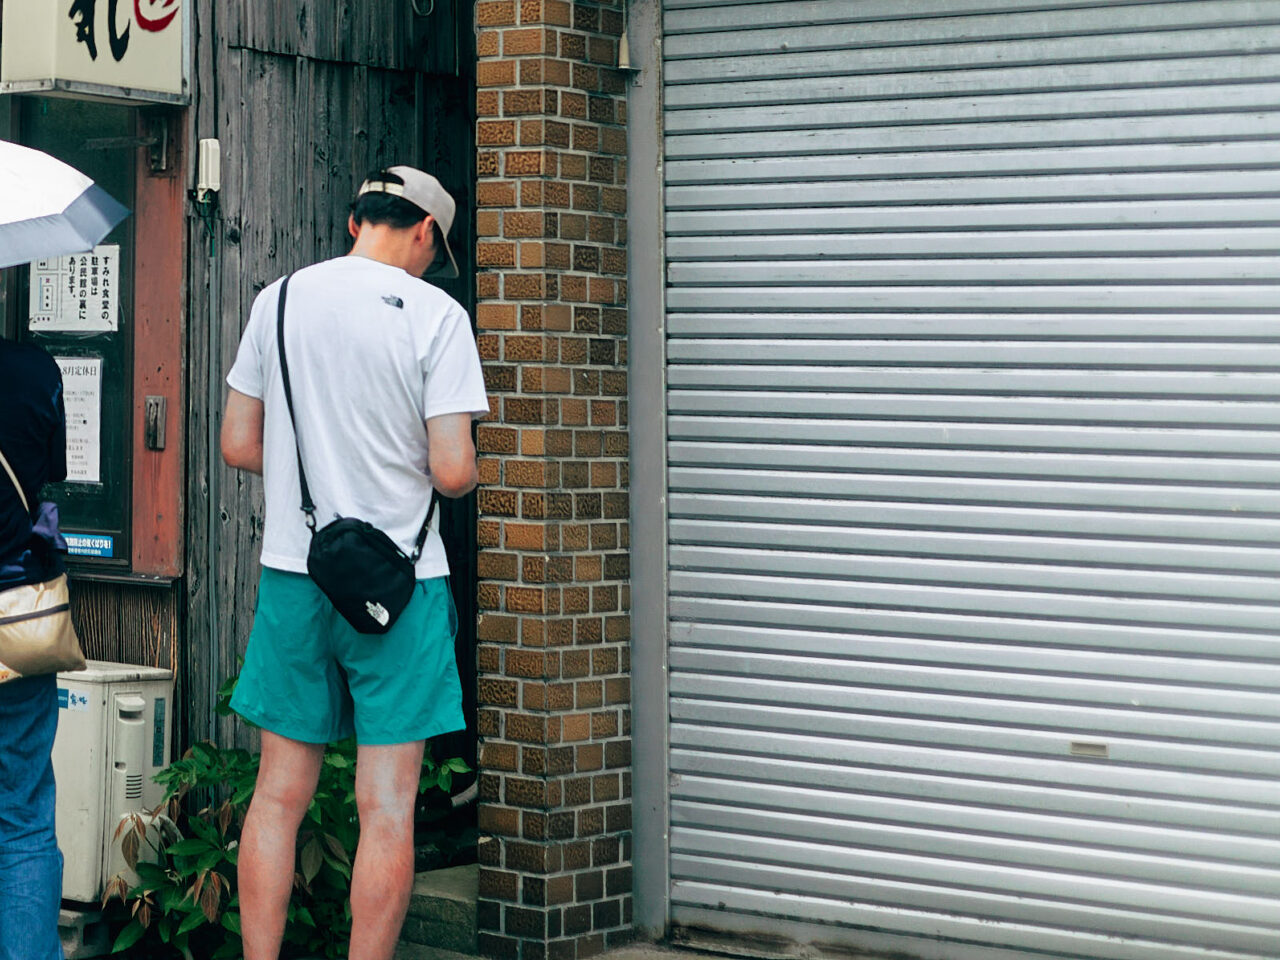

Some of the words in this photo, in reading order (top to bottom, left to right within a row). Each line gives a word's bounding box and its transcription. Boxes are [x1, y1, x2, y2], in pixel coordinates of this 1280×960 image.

[68, 256, 76, 298] あります。
[79, 256, 87, 320] 公民館の裏に
[102, 256, 110, 320] すみれ食堂の
